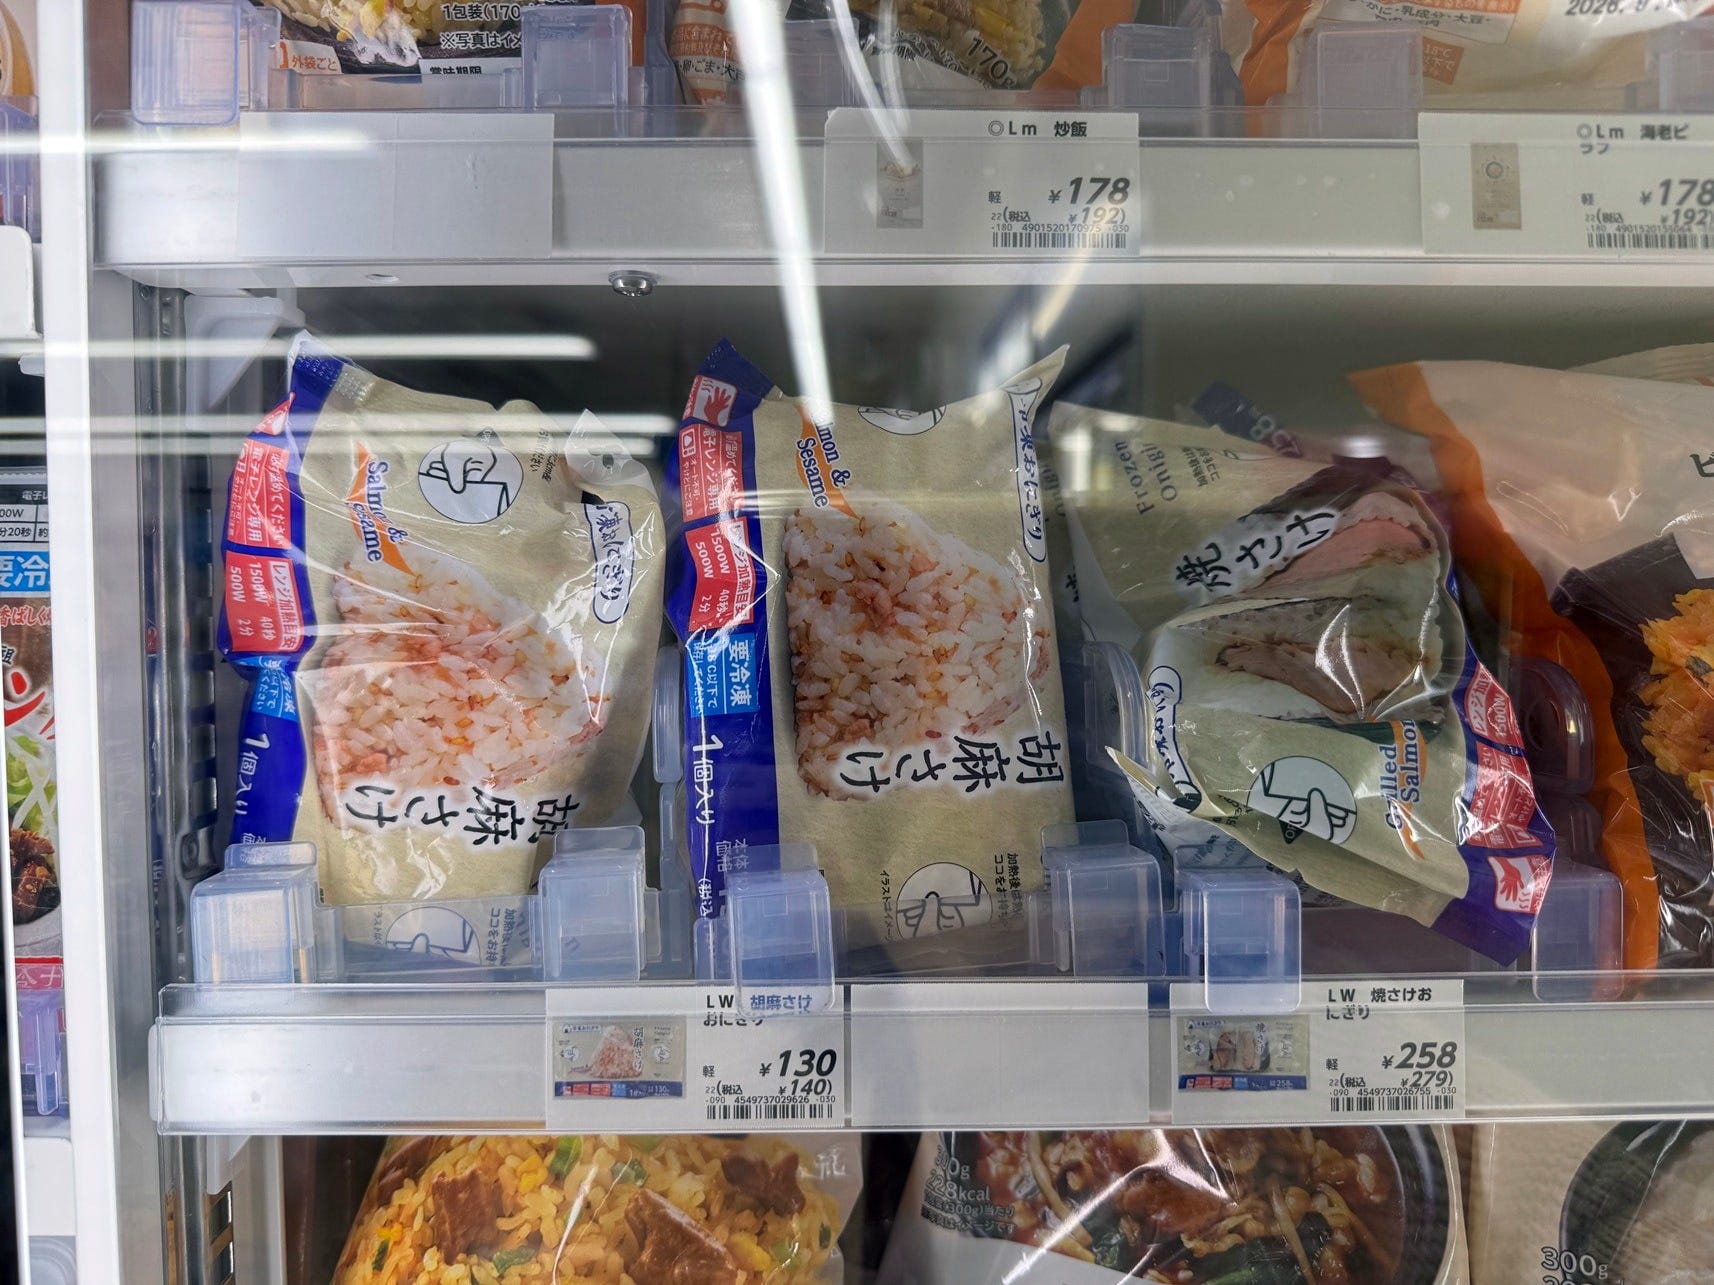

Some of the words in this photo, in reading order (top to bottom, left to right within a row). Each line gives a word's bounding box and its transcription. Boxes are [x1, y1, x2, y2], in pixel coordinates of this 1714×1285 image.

[292, 55, 337, 71] 外袋ごと
[1054, 121, 1087, 137] 炒飯
[988, 191, 1001, 204] 軽
[1048, 177, 1130, 205] ¥178
[702, 428, 719, 511] 電子レンジ専用
[796, 437, 828, 508] Sesame
[831, 469, 852, 489] &
[1115, 441, 1155, 515] Frozen
[695, 541, 715, 579] 500W
[710, 528, 730, 575] 1500W
[1175, 511, 1336, 593] 焼さけ
[229, 565, 246, 603] 500W
[0, 607, 51, 627] 香ばしく
[270, 561, 296, 650] レンジ加熱目安
[698, 595, 712, 614] 2分
[237, 618, 253, 637] 2分
[260, 616, 275, 641] 40秒
[729, 639, 752, 707] 要冷凍
[840, 730, 1064, 793] 胡麻さけ
[692, 734, 724, 825] 1個入り
[345, 785, 581, 847] 胡麻さけ
[750, 995, 813, 1014] 胡麻さけ
[1370, 988, 1432, 1002] 焼さけお
[702, 1065, 715, 1078] 軽
[759, 1049, 837, 1077] ¥130
[1326, 1058, 1338, 1070] 軽
[1381, 1041, 1458, 1069] ¥258
[778, 1079, 833, 1096] ¥140)
[1357, 1087, 1431, 1096] 4549737026755
[1400, 1070, 1454, 1088] ¥279)
[734, 1095, 810, 1104] 4549737029626
[1540, 1246, 1608, 1280] 300g
